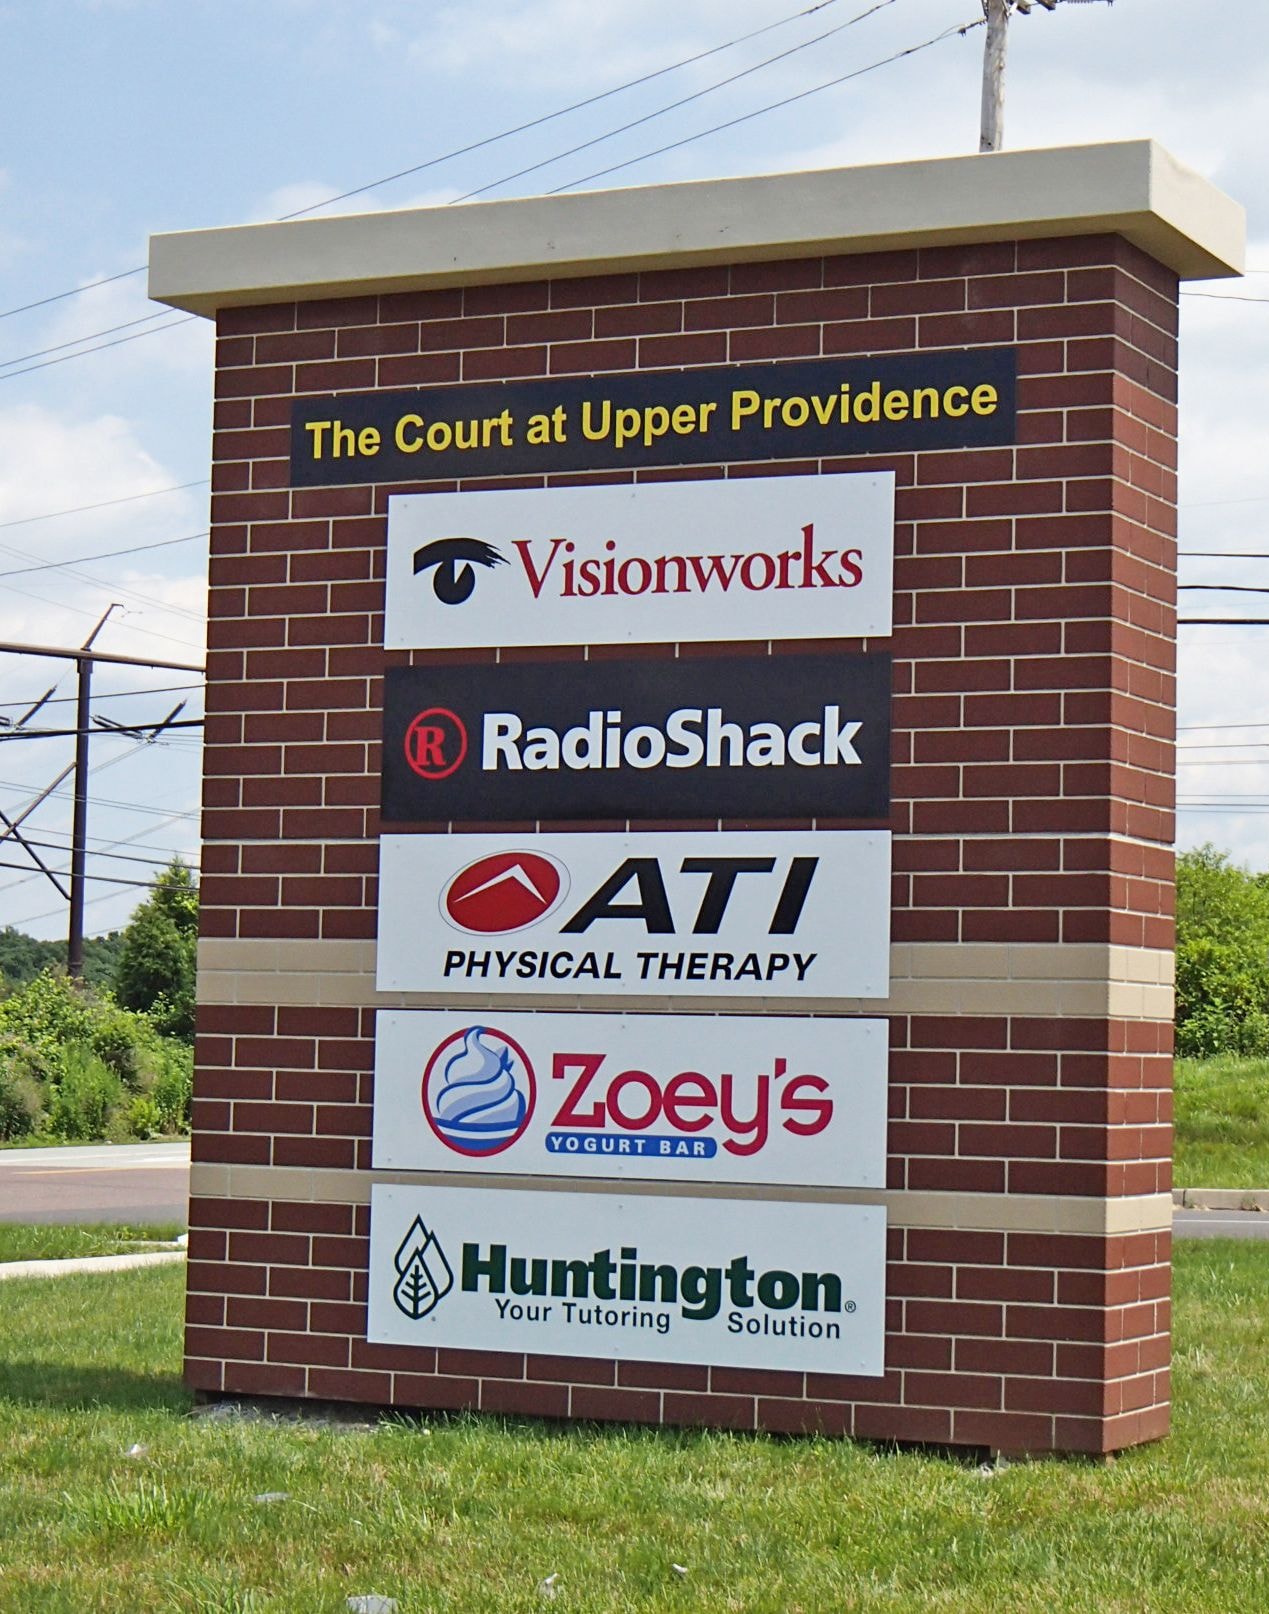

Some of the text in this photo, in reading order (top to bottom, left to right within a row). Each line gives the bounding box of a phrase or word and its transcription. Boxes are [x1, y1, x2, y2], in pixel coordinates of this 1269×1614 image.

[307, 384, 997, 458] The Court at Upper Providence
[511, 523, 863, 599] Visionworks
[483, 706, 862, 769] RadioShack
[558, 857, 819, 935] ATI
[444, 951, 817, 980] PHYSICAL THERAPY
[551, 1053, 833, 1157] Zoey's
[551, 1136, 706, 1156] YOGURT BAR
[495, 1299, 841, 1339] Your Tutoring Solution
